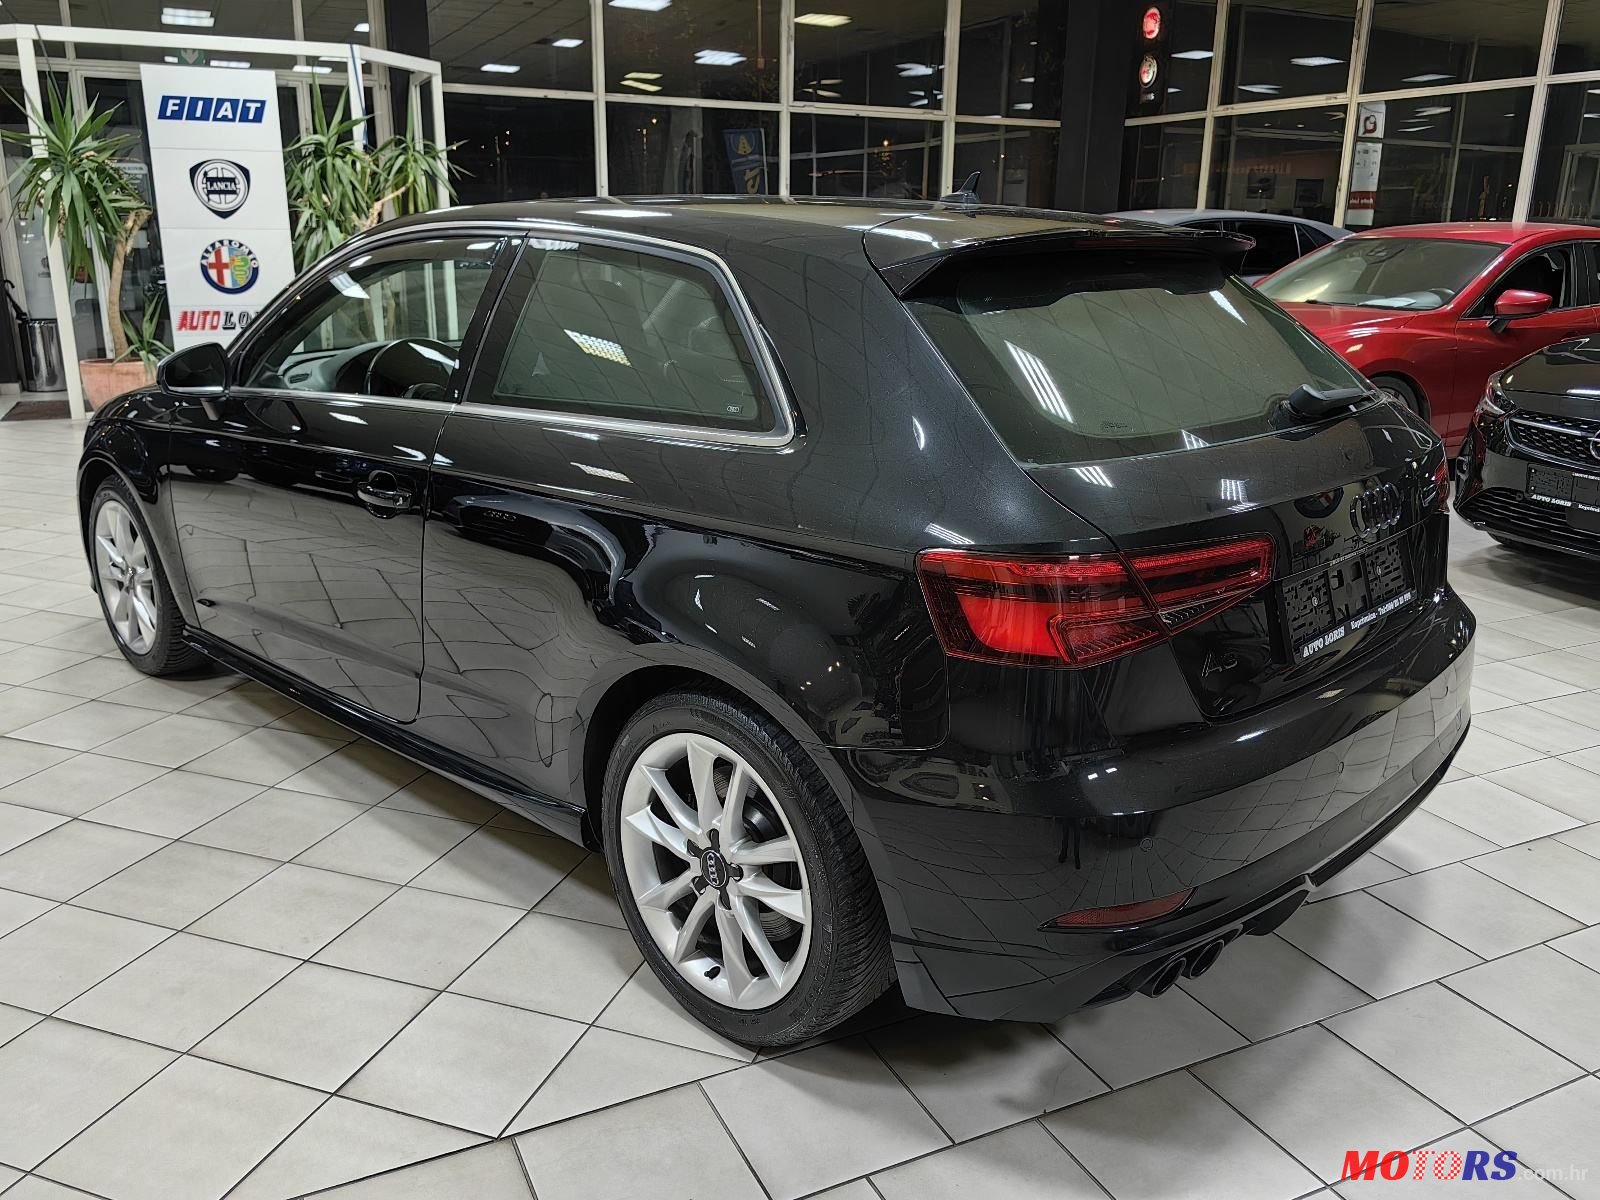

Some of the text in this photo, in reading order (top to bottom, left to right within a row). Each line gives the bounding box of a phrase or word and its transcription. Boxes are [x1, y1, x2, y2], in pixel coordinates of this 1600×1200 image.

[164, 98, 262, 120] FIAT
[206, 181, 237, 191] LANCIA
[177, 311, 261, 331] AUTO LO
[1531, 494, 1551, 503] AUTO
[1302, 637, 1324, 658] AUTO
[1324, 625, 1346, 647] LORIS
